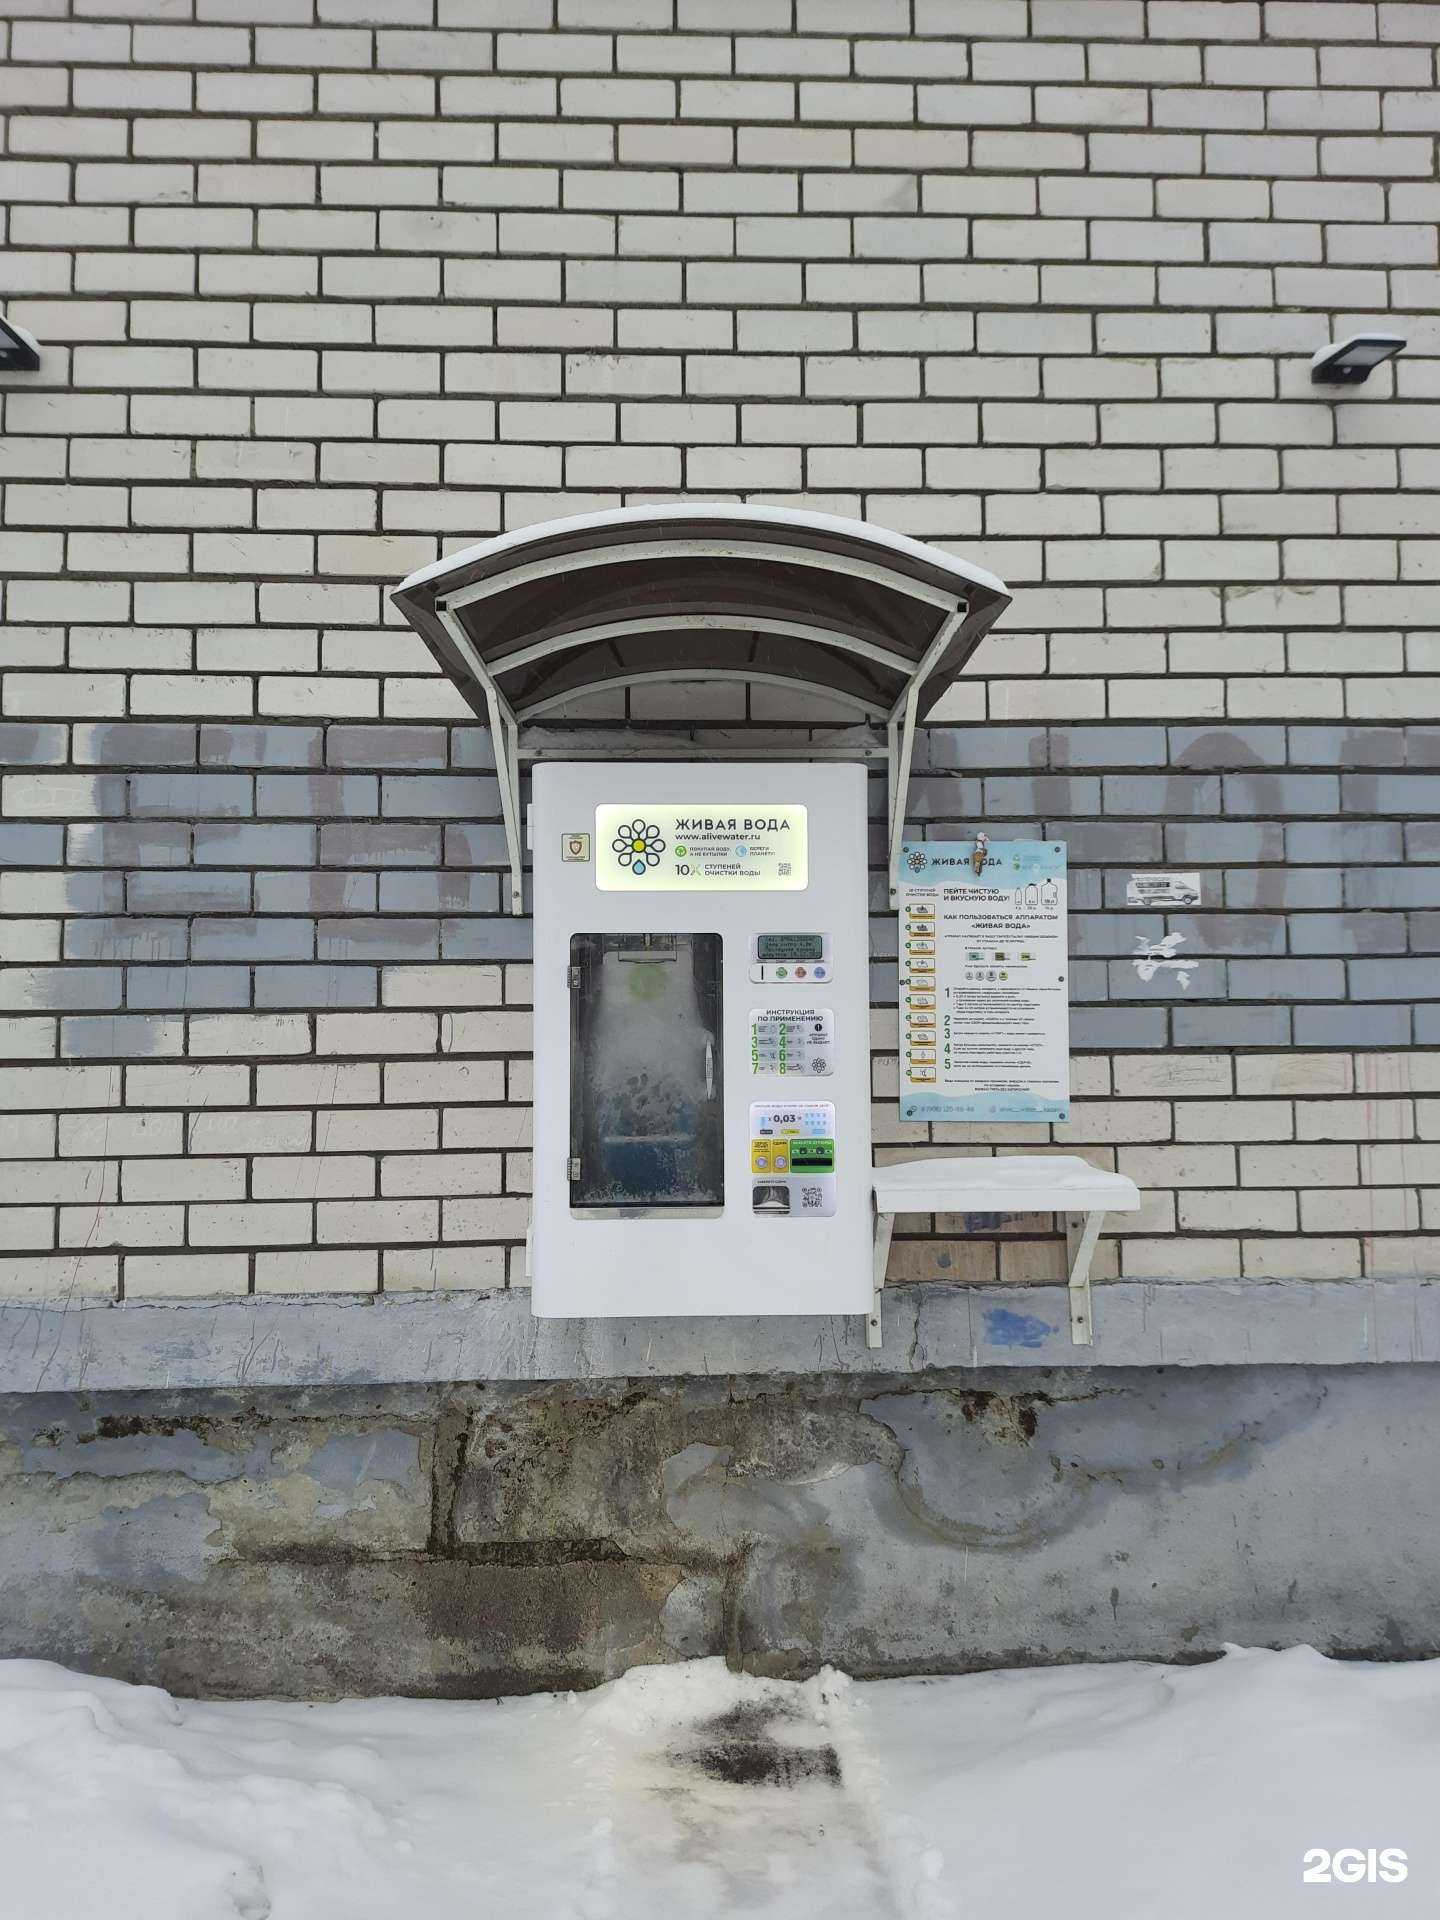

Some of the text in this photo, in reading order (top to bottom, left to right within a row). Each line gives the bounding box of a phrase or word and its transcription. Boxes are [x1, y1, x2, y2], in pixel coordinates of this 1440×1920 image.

[675, 818, 791, 832] ЖИВАЯ ВОДА
[675, 832, 761, 841] www.alivewater.ru
[931, 857, 970, 866] ЖИВАЯ
[943, 887, 967, 895] ПЕЙТЕ
[1005, 922, 1031, 930] ВОДА»
[944, 987, 950, 998] 1
[943, 1015, 951, 1026] 2
[751, 1023, 757, 1035] 1
[779, 1023, 786, 1035] 2
[943, 1028, 951, 1039] 3
[751, 1036, 758, 1048] 3
[779, 1036, 787, 1048] 4
[943, 1043, 951, 1054] 4
[751, 1049, 758, 1062] 5
[779, 1049, 786, 1062] 6
[751, 1062, 759, 1075] 7
[779, 1062, 786, 1075] 8
[944, 1058, 951, 1070] 5
[773, 1114, 796, 1124] 0,03
